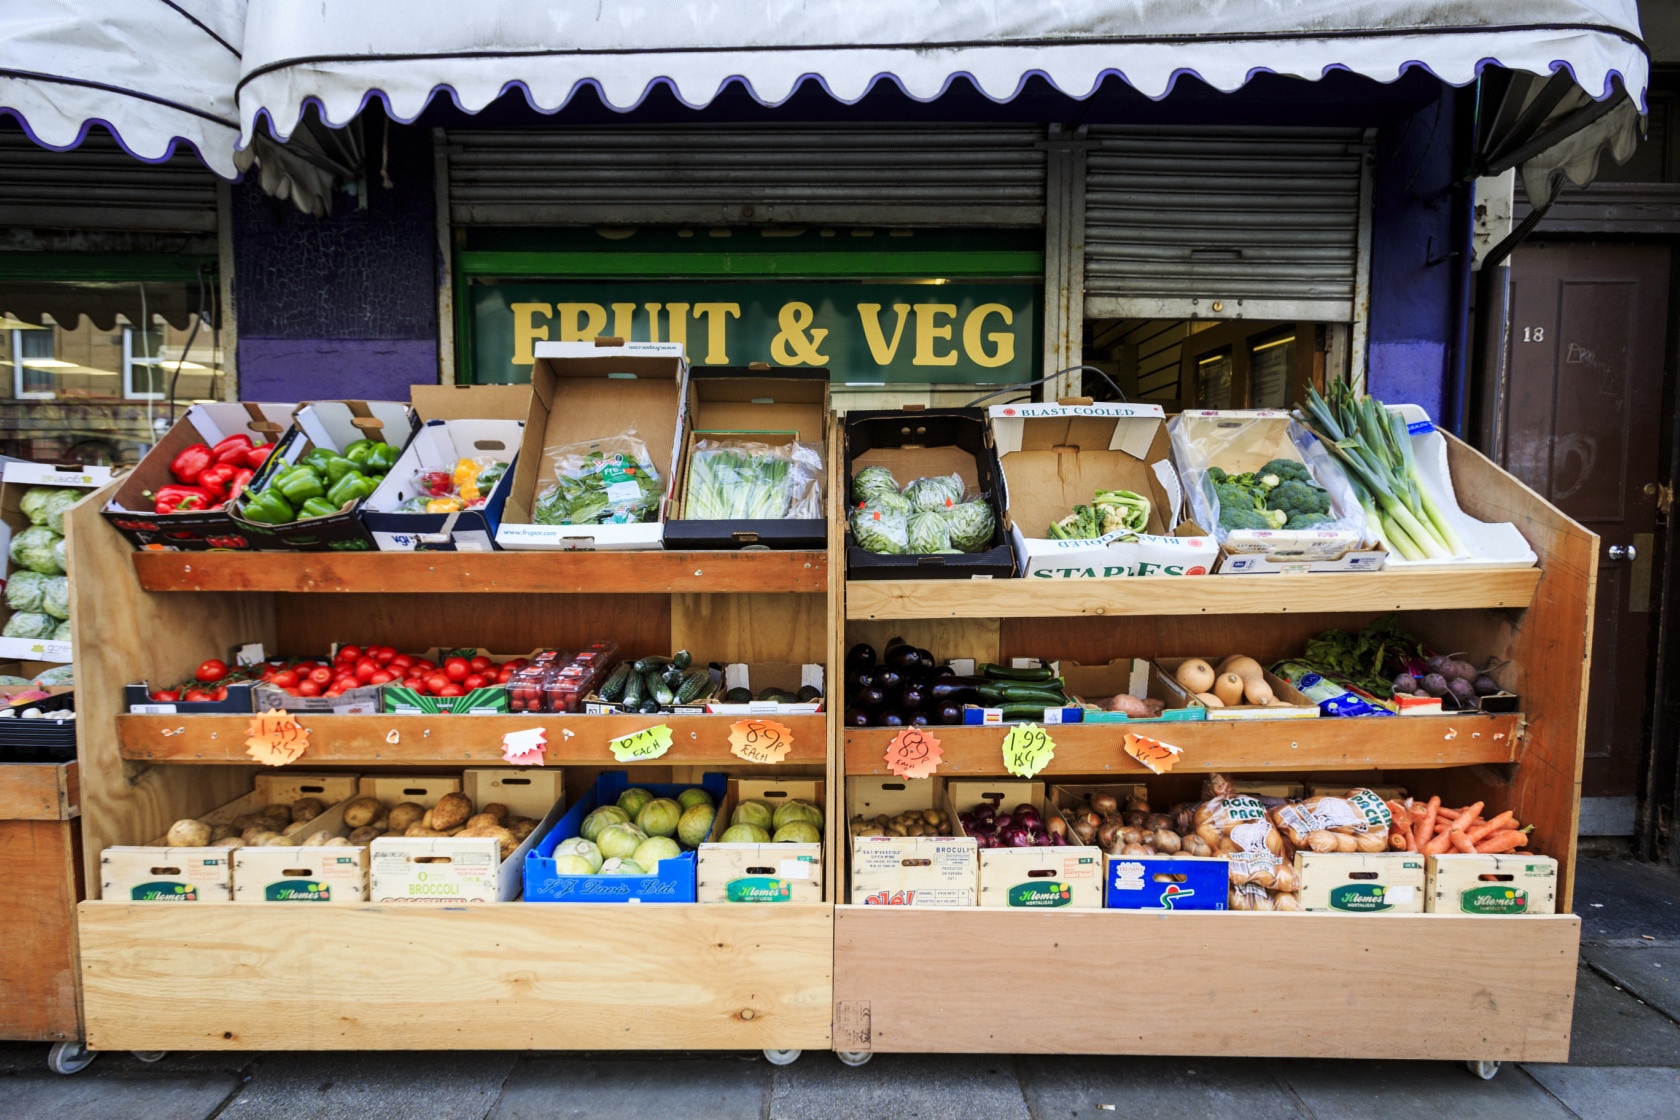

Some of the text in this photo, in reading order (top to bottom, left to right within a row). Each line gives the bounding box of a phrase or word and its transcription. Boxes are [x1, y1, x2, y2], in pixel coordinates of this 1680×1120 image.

[510, 301, 1015, 368] FRUIT & VEG
[1523, 326, 1545, 342] 18
[1021, 407, 1135, 417] BLAST COOLED
[632, 740, 661, 757] EACH
[740, 744, 769, 762] EACH
[1229, 808, 1266, 820] PACK
[408, 883, 460, 895] BROCCOLI
[580, 879, 630, 895] Davis
